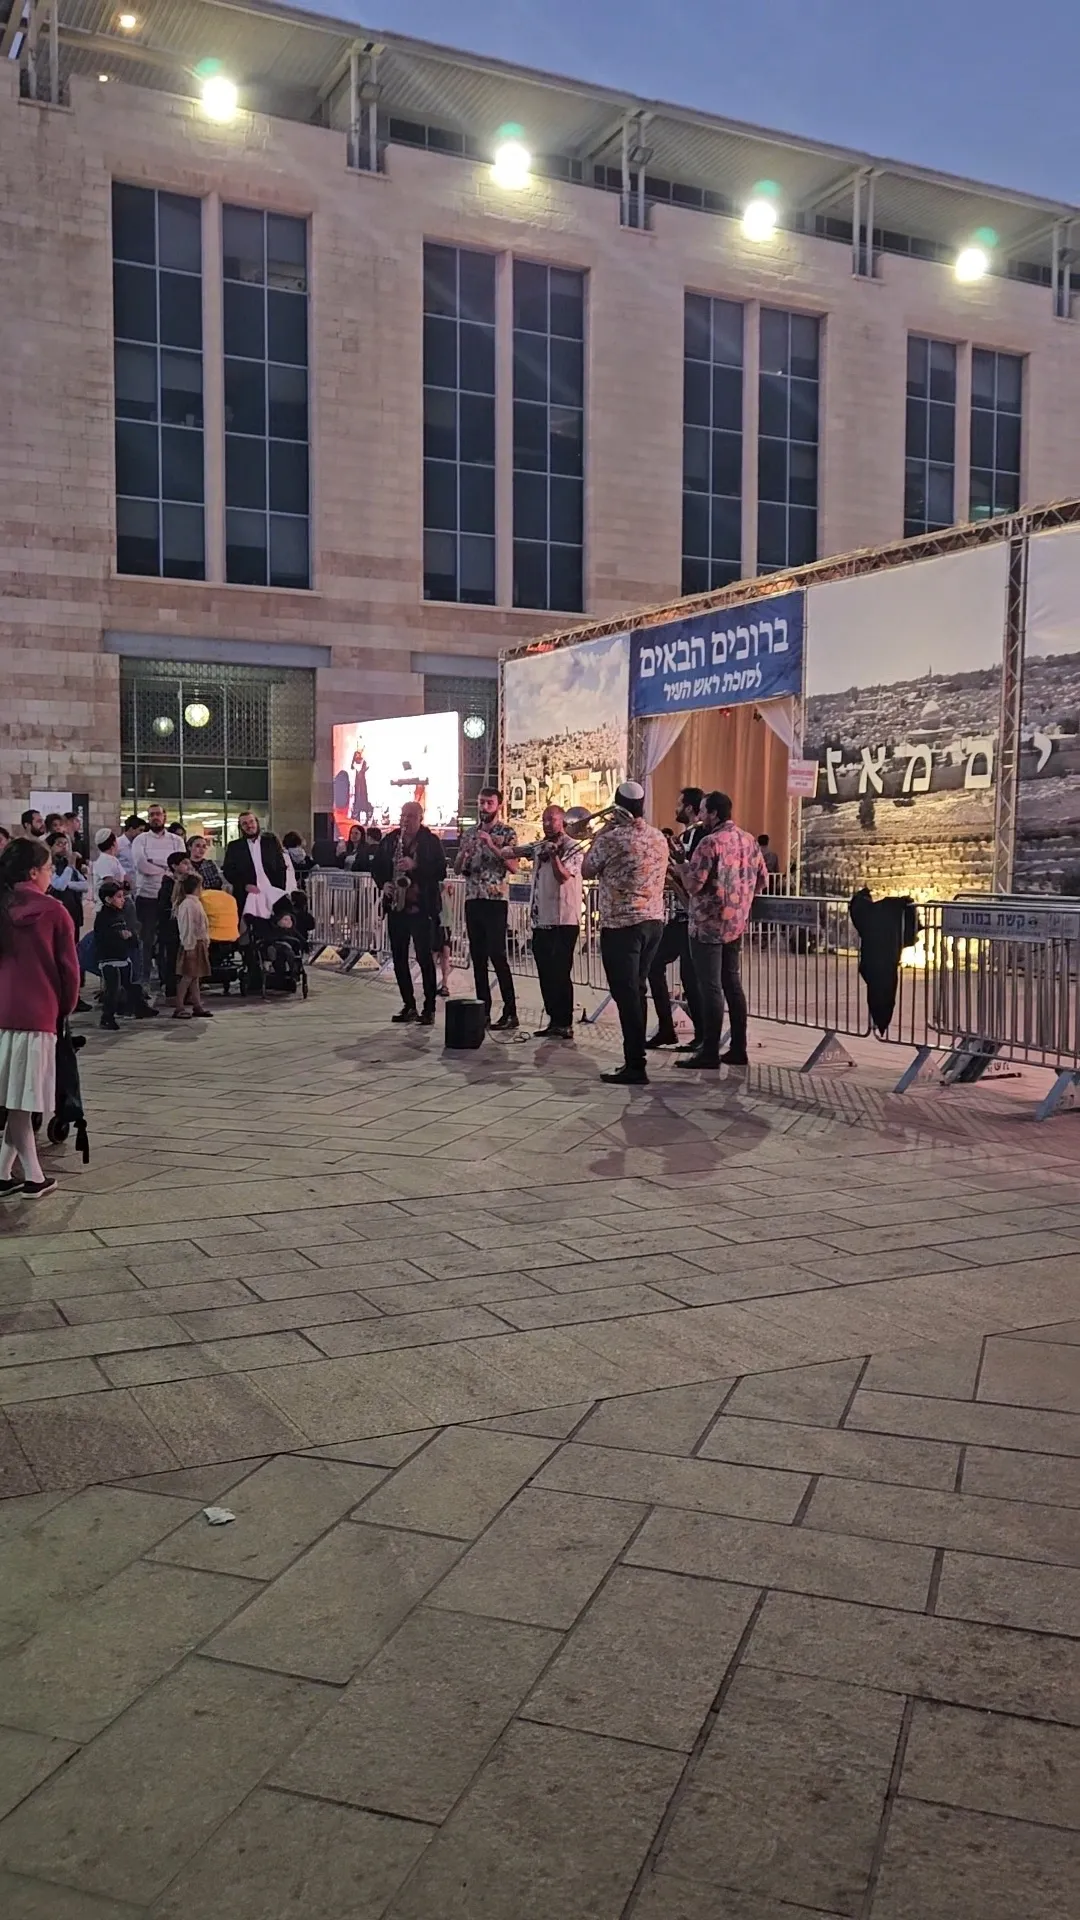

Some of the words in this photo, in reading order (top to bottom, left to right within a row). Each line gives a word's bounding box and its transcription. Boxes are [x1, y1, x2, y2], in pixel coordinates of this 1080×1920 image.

[711, 617, 789, 665] ברוכים
[640, 636, 706, 678] הבאים
[693, 674, 721, 697] ראש
[722, 662, 762, 692] לסוכת
[663, 679, 692, 702] העיר
[826, 742, 932, 794] מאז
[962, 912, 991, 926] במות
[996, 912, 1025, 929] קשת
